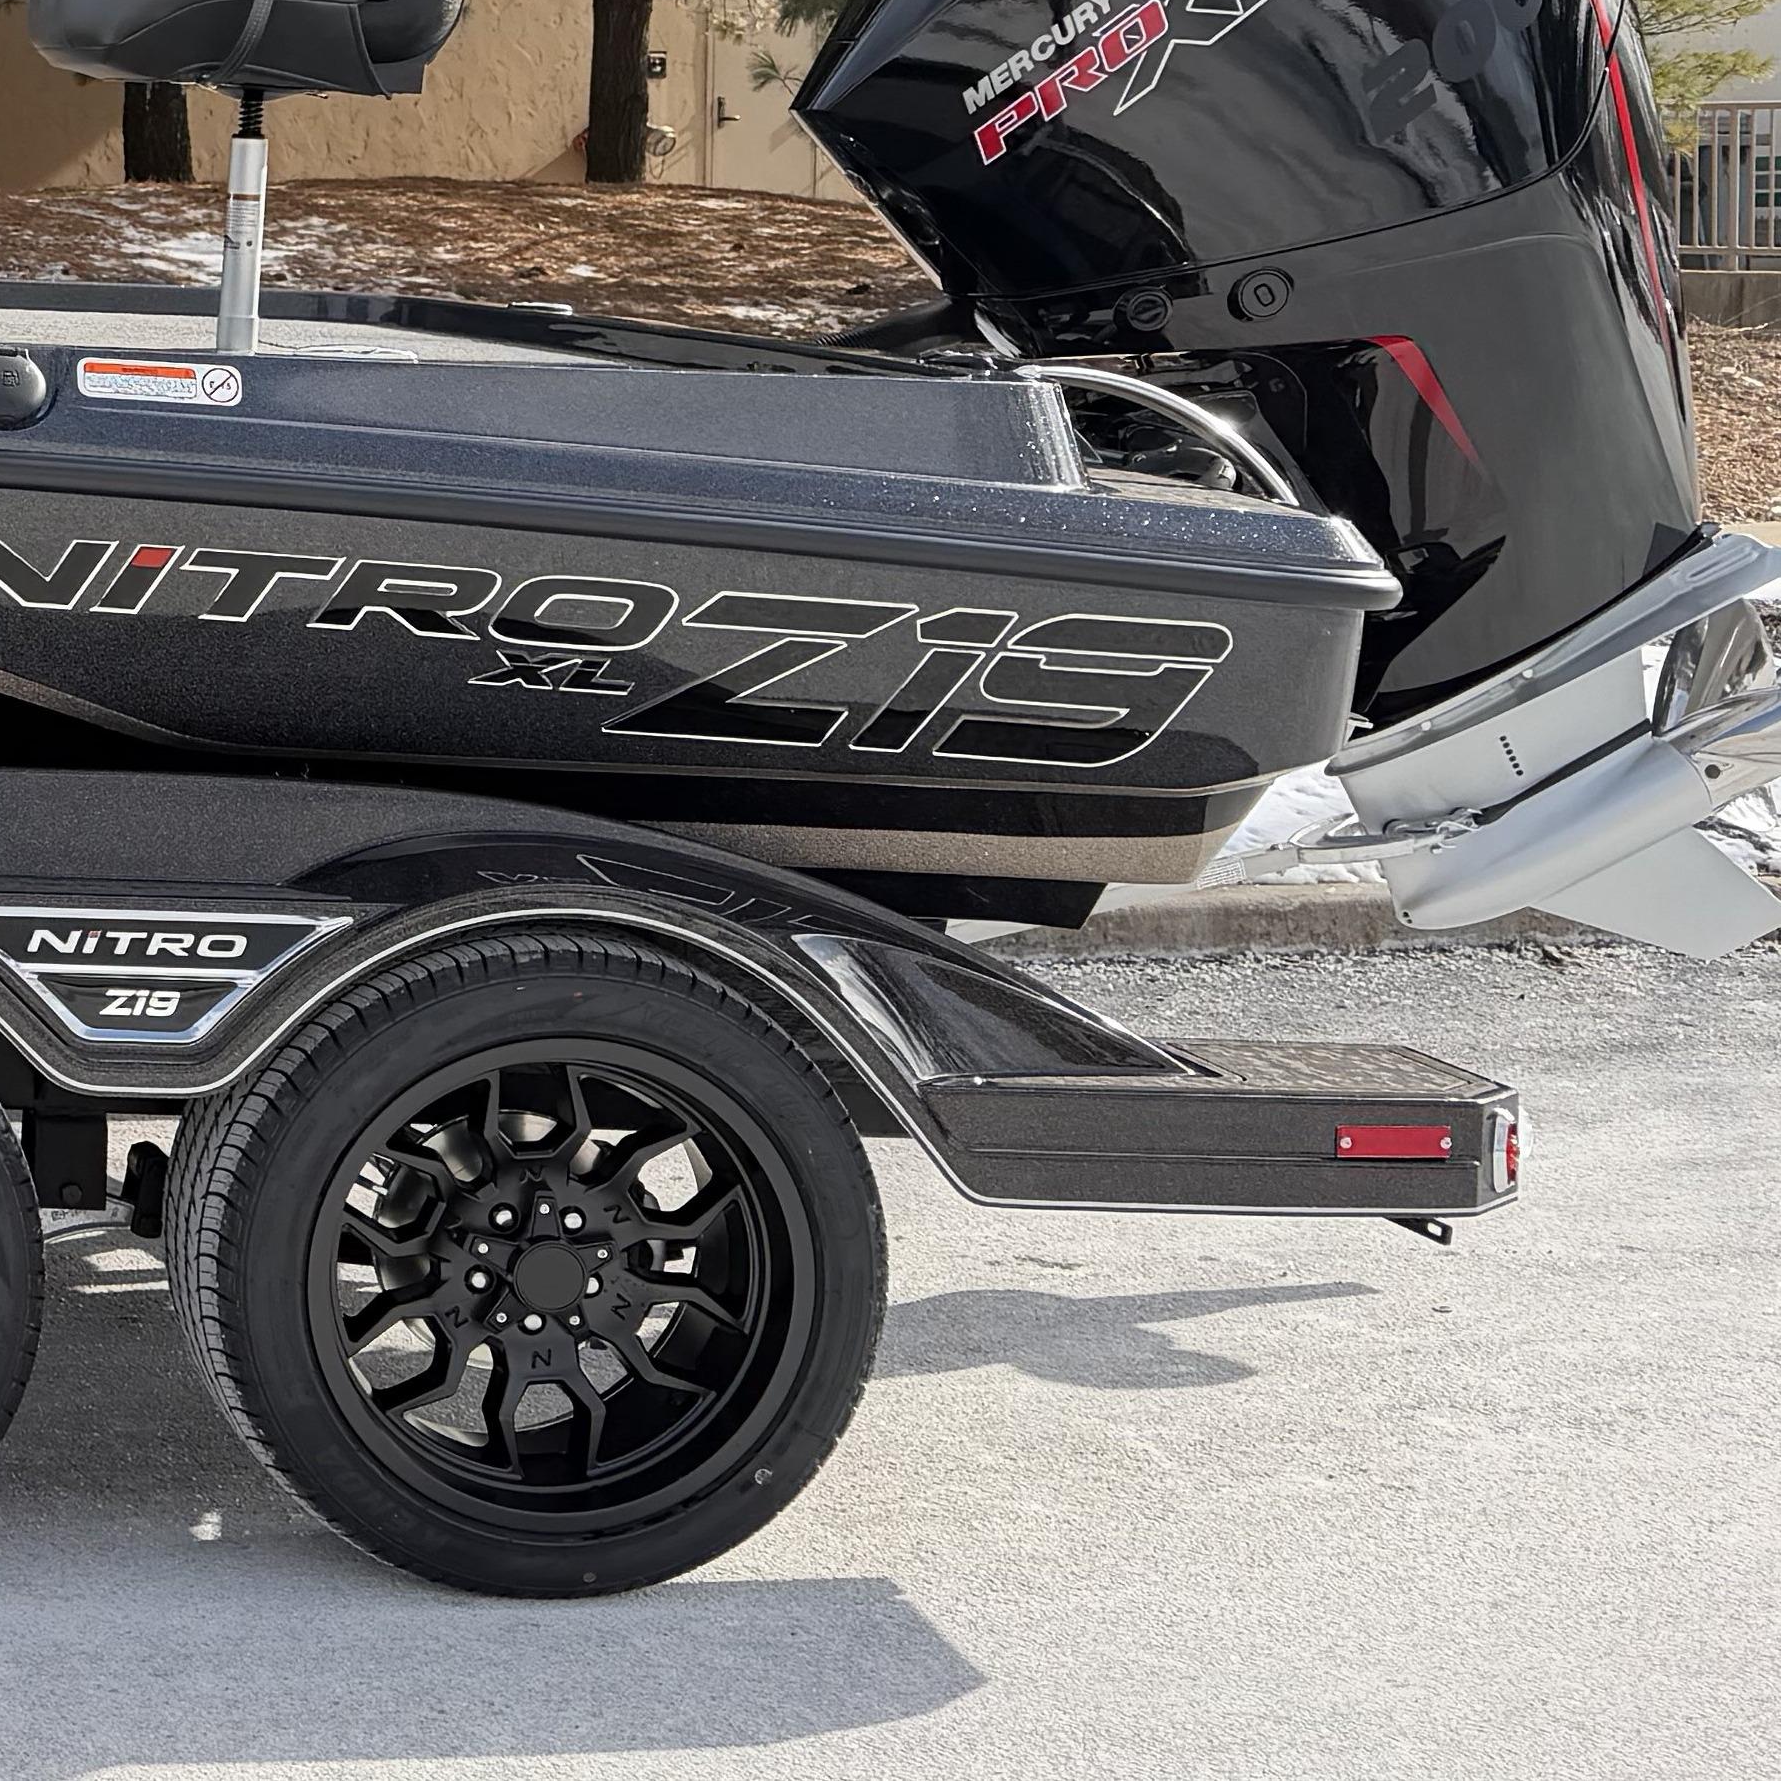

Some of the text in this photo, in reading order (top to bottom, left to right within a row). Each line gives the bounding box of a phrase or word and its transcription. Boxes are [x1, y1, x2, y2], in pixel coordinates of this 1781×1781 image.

[468, 650, 636, 695] XL
[601, 590, 1234, 767] Z19
[98, 988, 181, 1018] Z19
[530, 1348, 552, 1369] N
